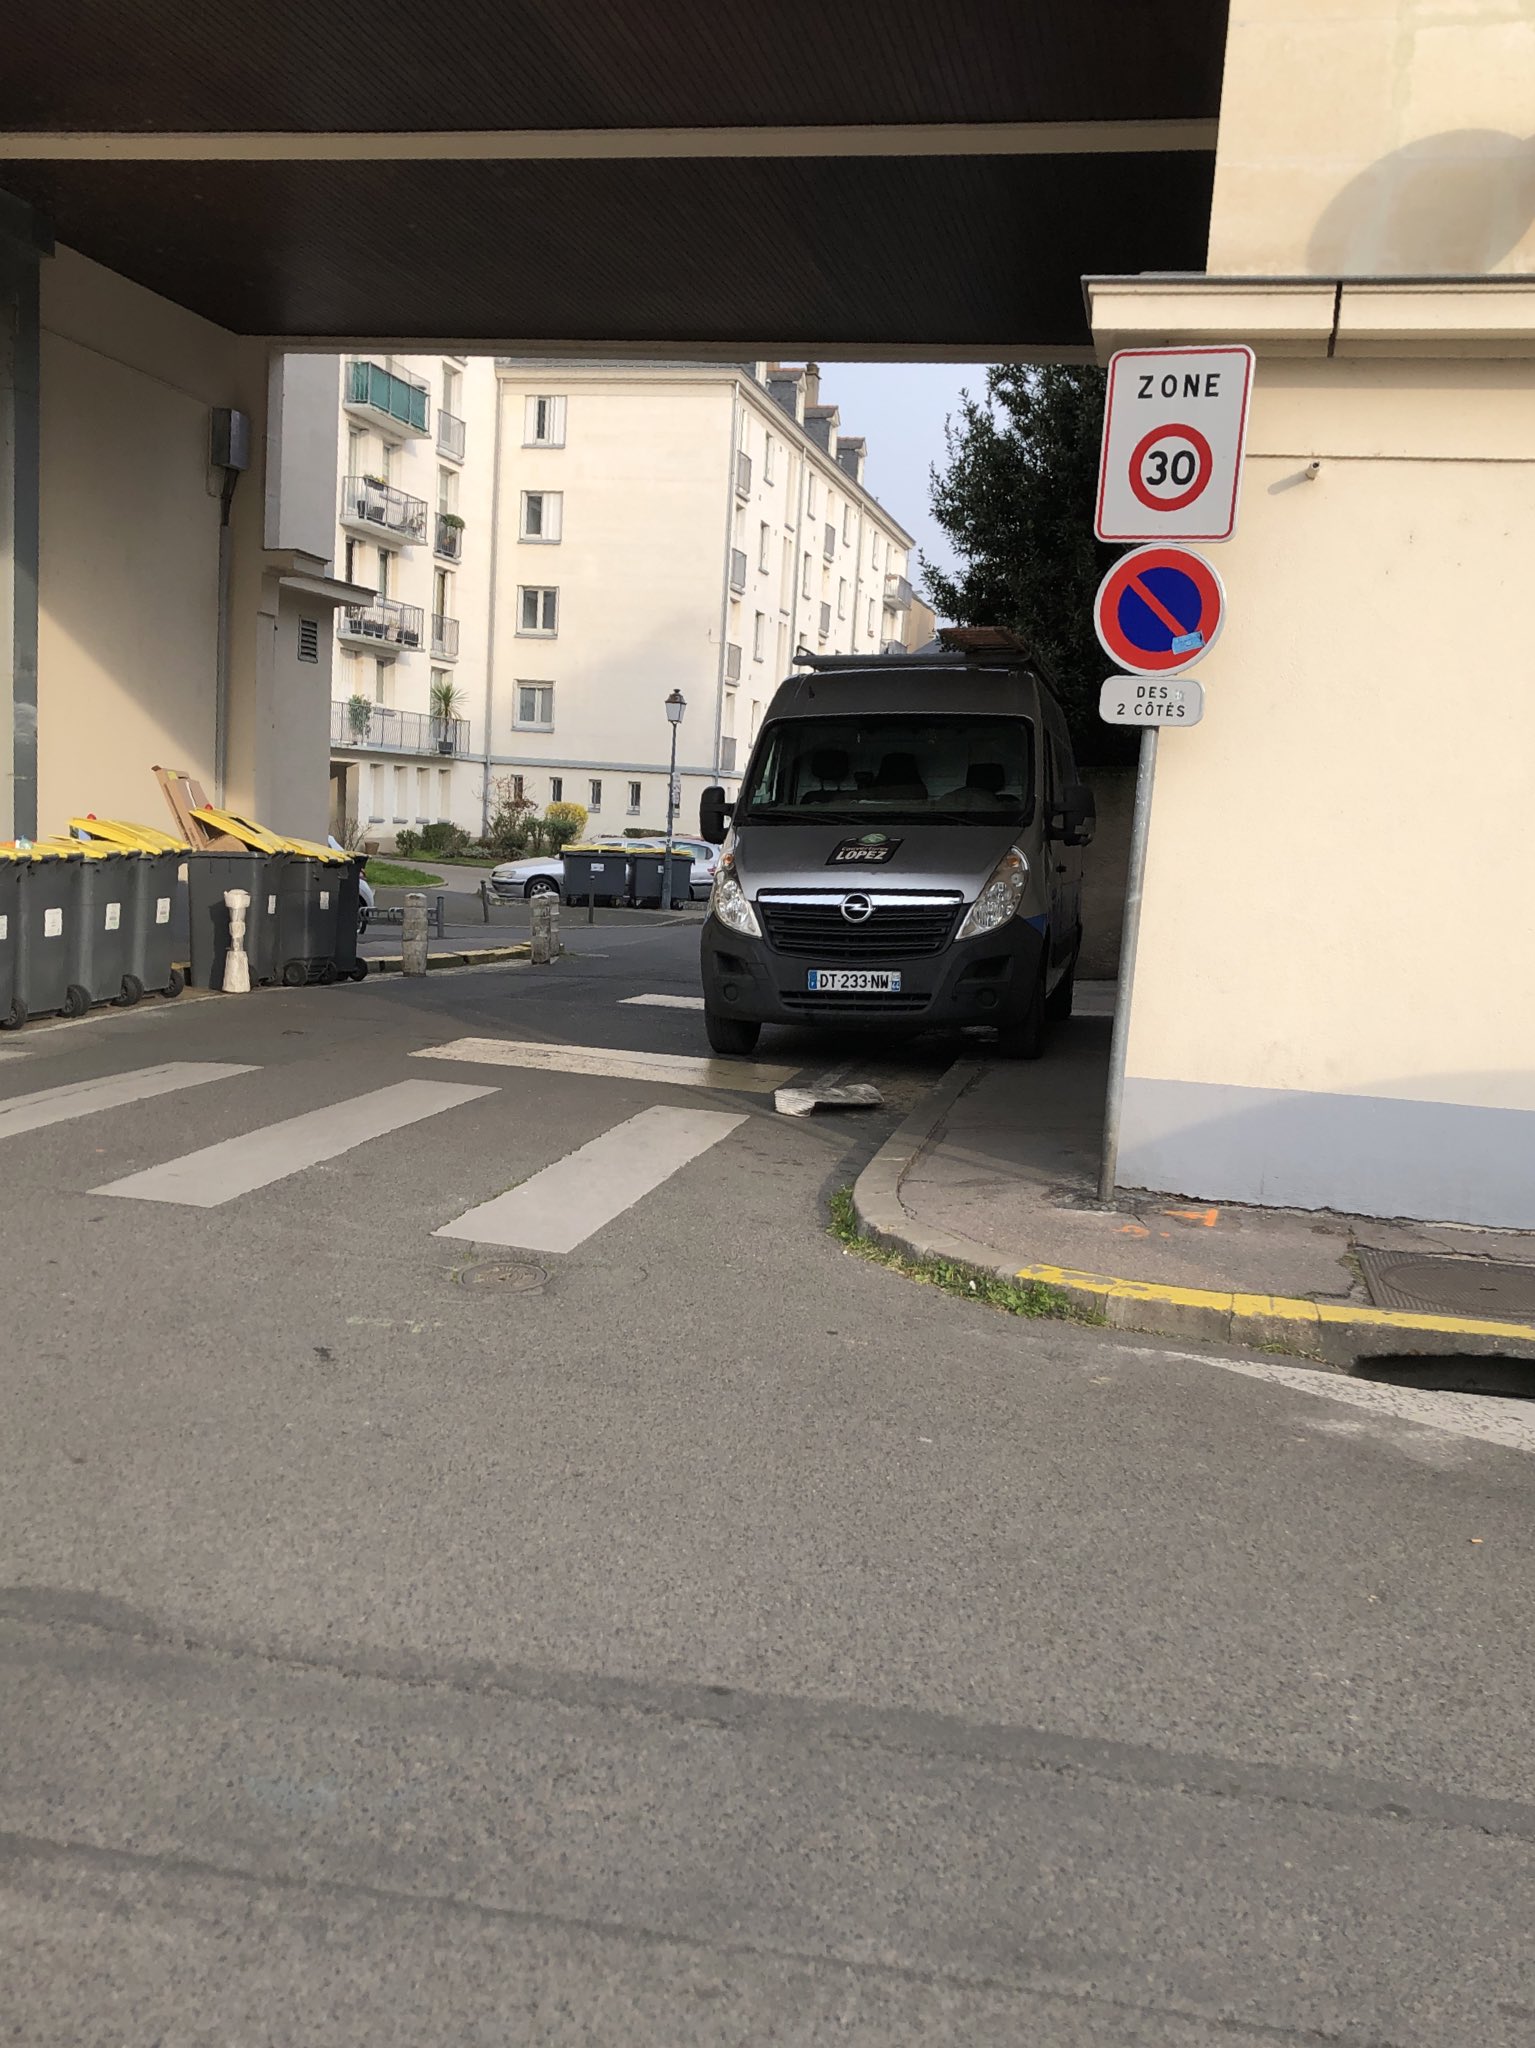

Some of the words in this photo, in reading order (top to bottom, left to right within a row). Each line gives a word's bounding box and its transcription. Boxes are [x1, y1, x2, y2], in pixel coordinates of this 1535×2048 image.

[1138, 373, 1221, 399] ZONE
[1146, 450, 1196, 486] 30
[1136, 686, 1168, 699] DES
[1116, 703, 1126, 716] 2
[1134, 701, 1185, 718] CÔTÉS
[835, 850, 887, 860] LOPEZ
